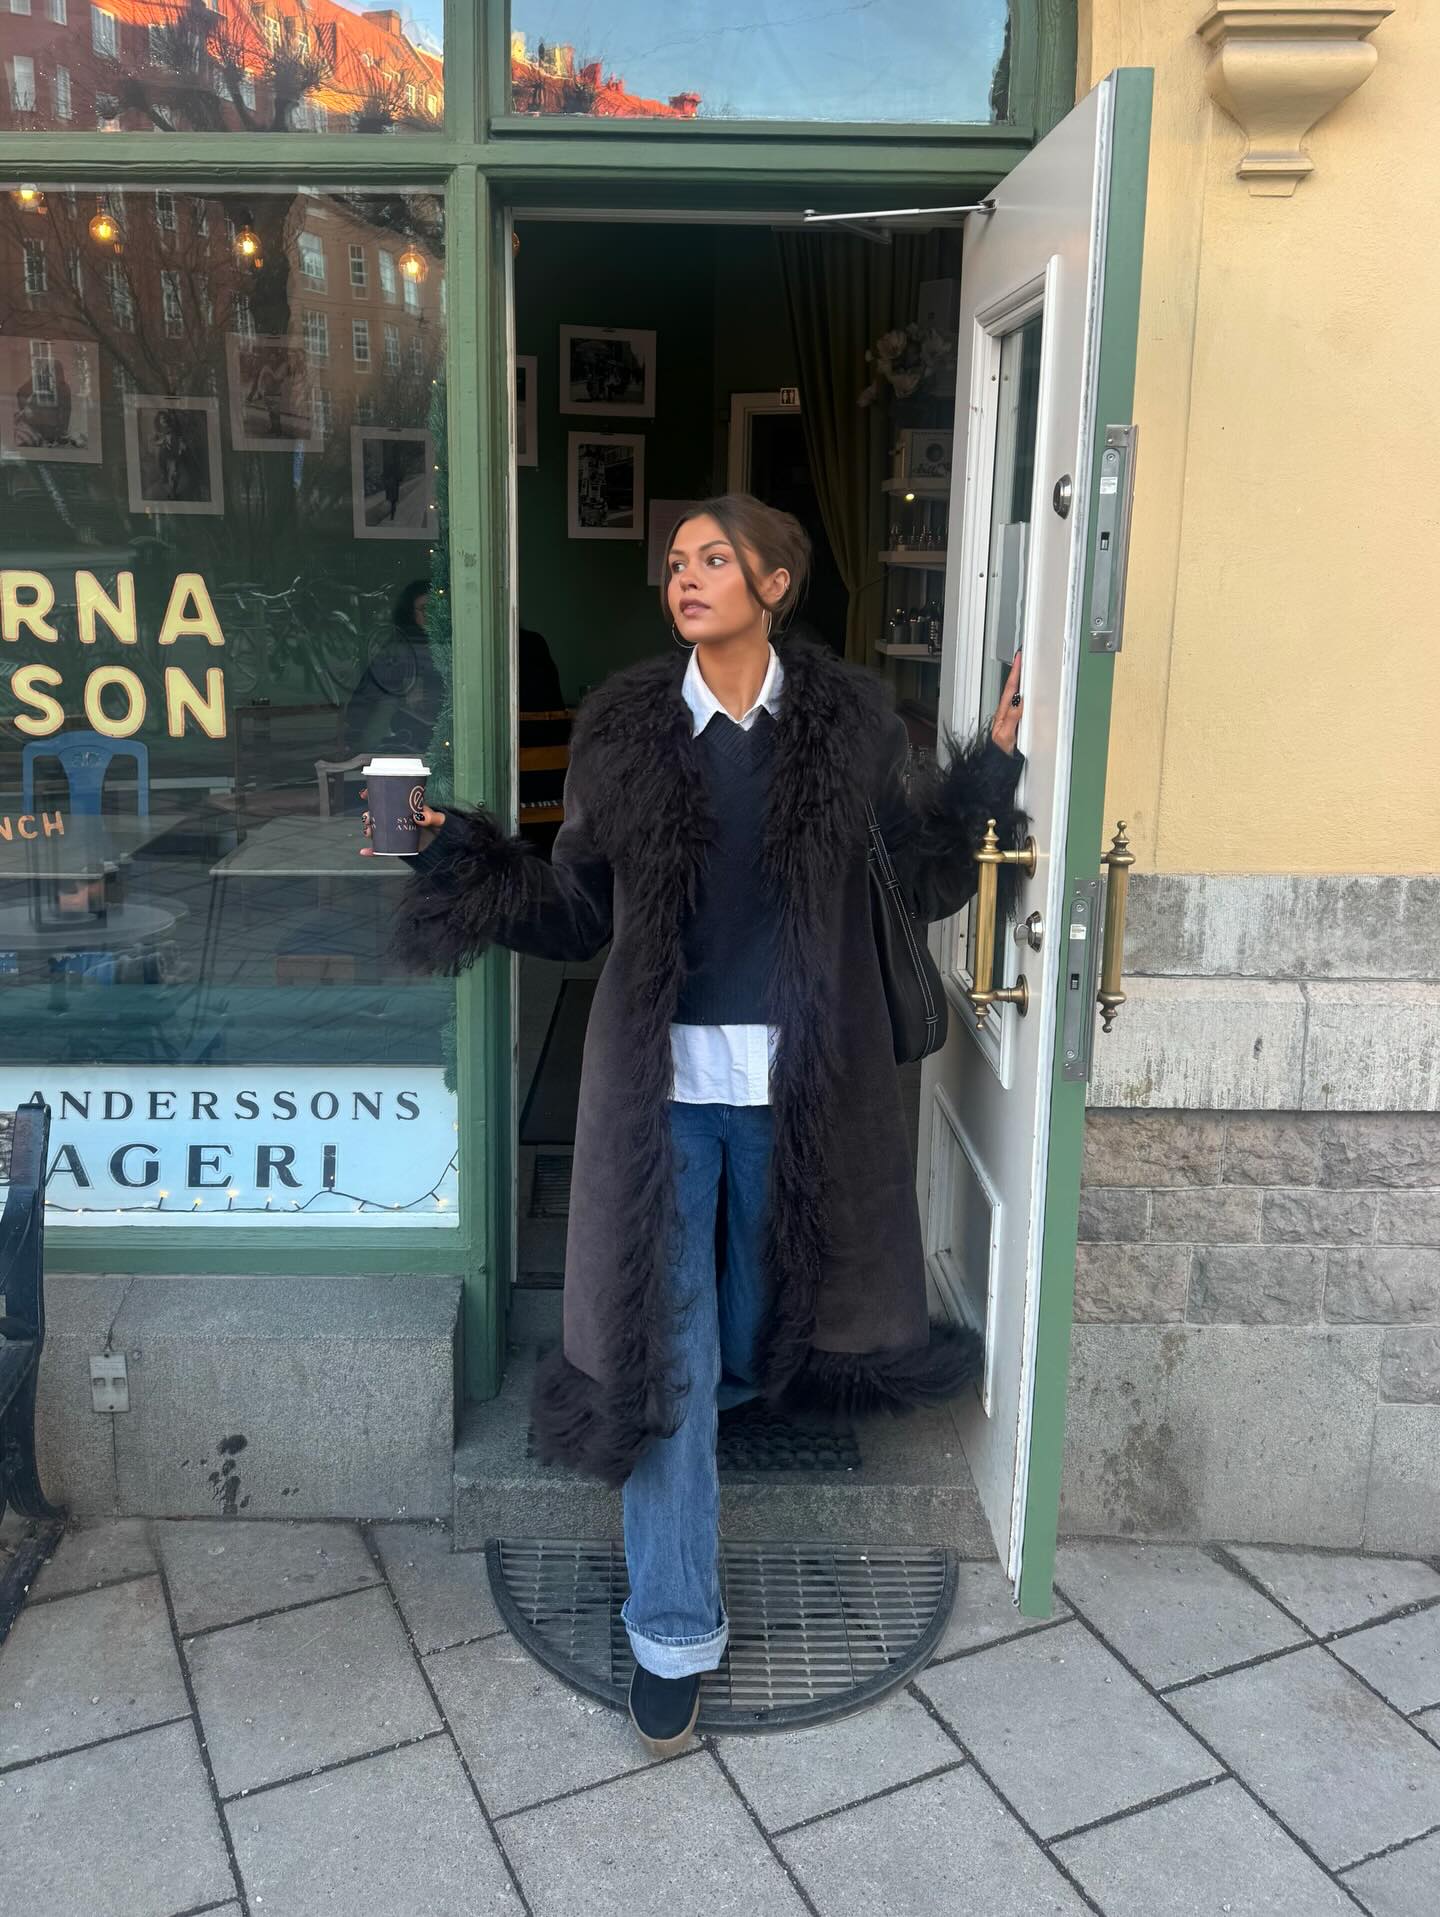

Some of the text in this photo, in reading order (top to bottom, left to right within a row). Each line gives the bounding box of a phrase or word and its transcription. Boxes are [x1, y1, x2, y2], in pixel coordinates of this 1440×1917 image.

[0, 569, 225, 646] RNA
[10, 663, 227, 739] SON
[0, 1143, 338, 1189] AGERI
